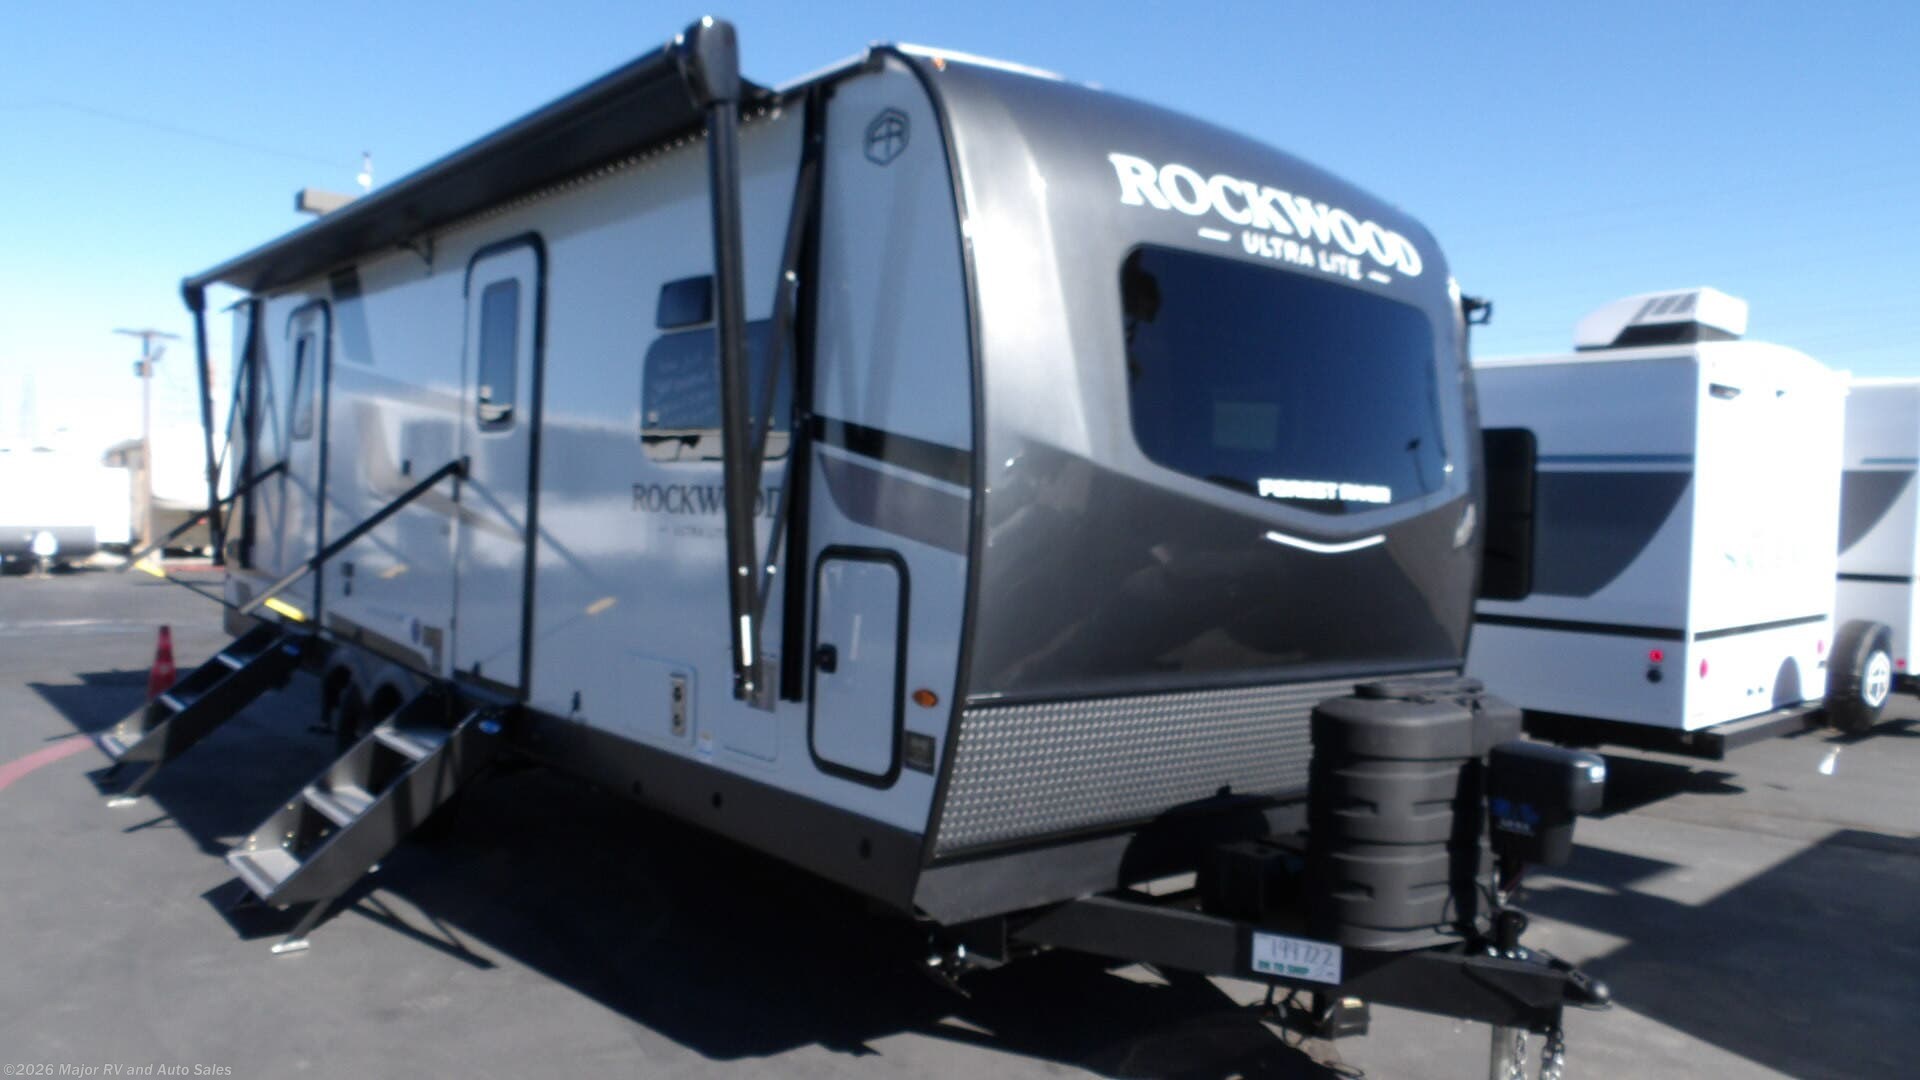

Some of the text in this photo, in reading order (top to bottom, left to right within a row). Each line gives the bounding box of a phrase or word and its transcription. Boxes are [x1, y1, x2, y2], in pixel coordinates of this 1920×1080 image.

[1108, 152, 1423, 277] ROCKWOOD
[1241, 231, 1362, 280] ULTRA LITE
